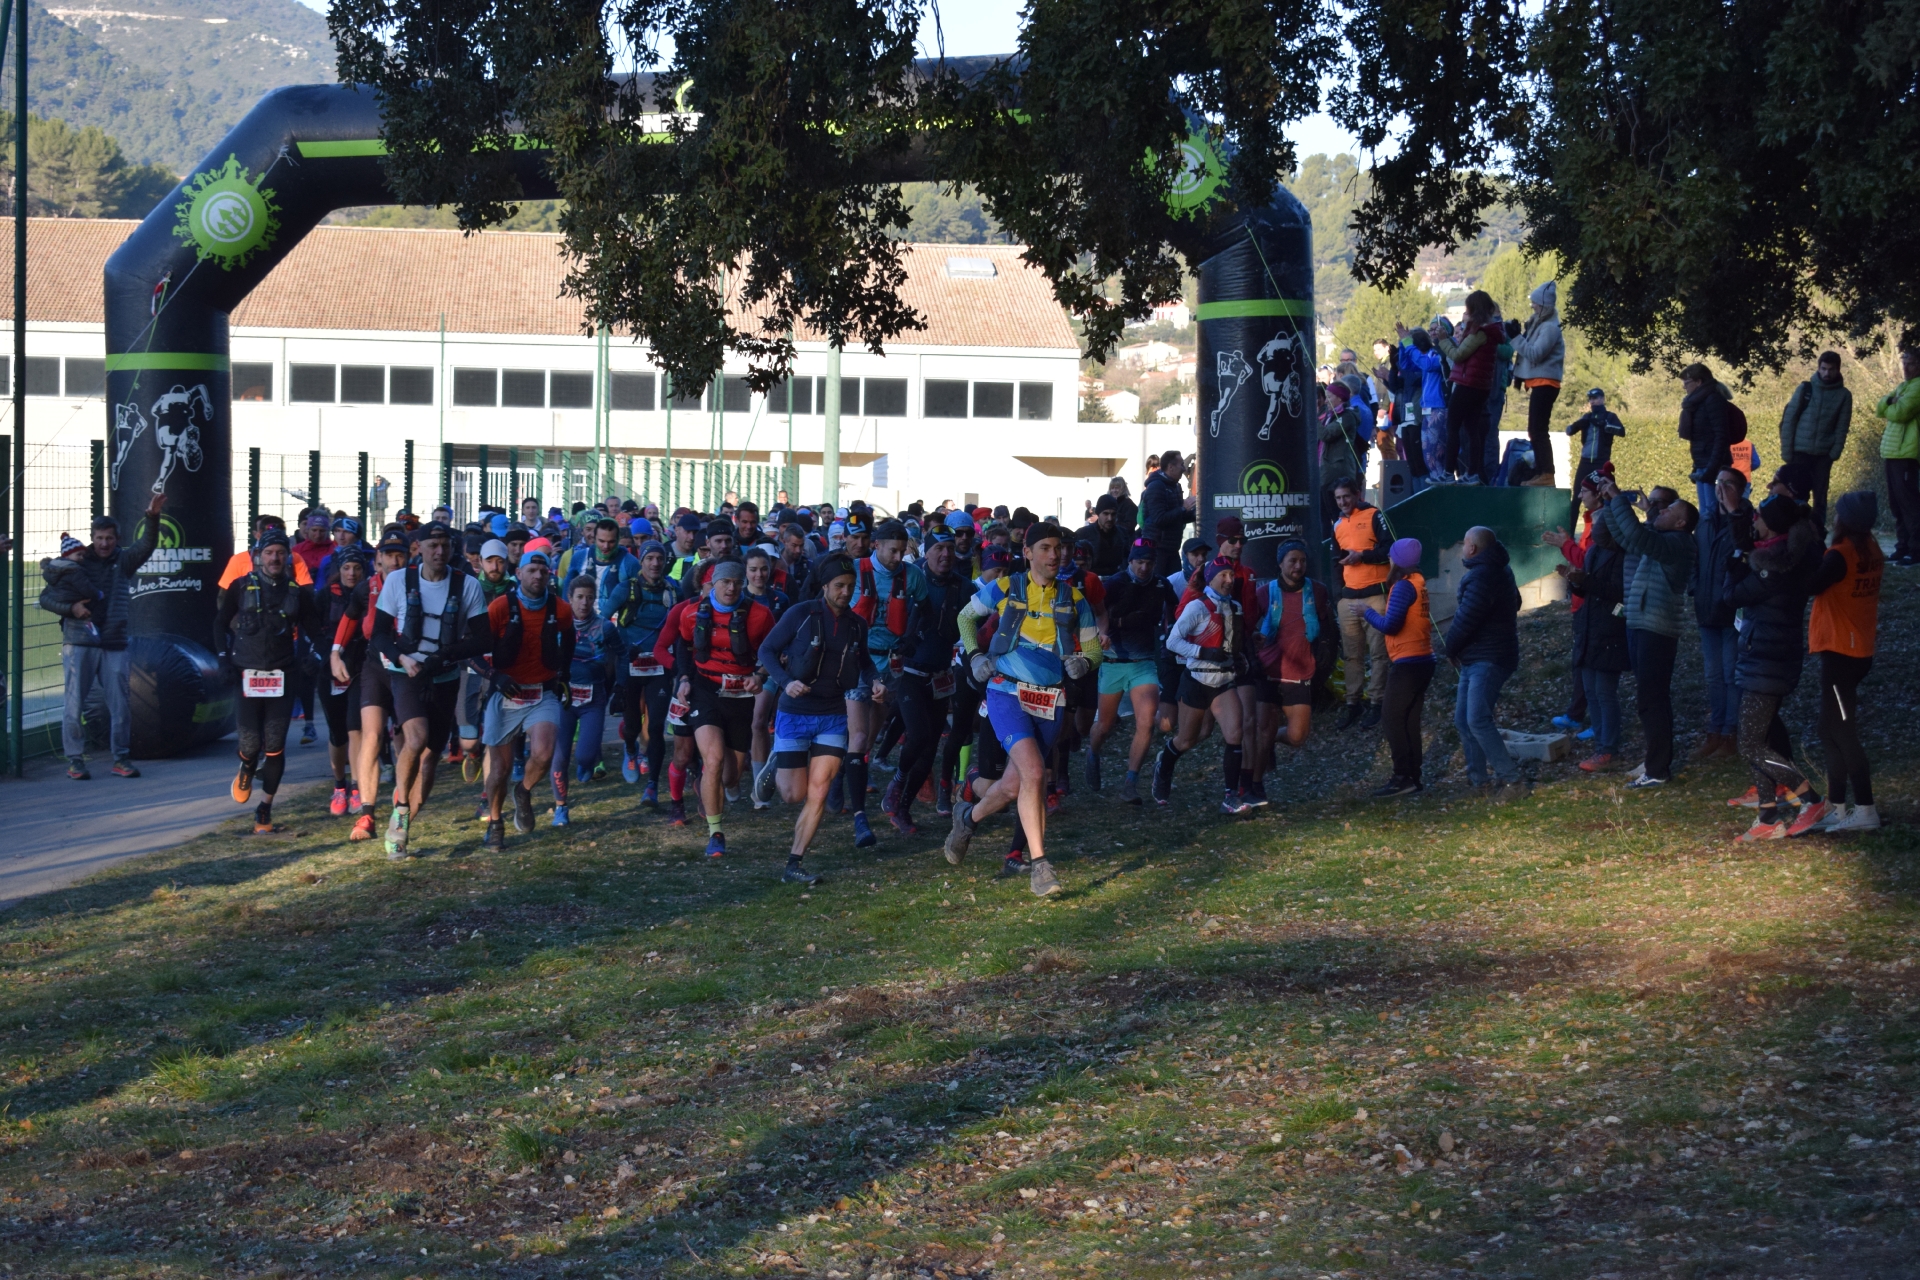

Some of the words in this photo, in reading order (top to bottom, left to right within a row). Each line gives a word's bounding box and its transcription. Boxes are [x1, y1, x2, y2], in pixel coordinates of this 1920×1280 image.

[1214, 494, 1310, 508] ENDURANCE
[1242, 506, 1287, 519] SHOP
[1265, 522, 1303, 535] Running
[150, 548, 212, 561] RANCE
[137, 578, 157, 592] love
[158, 576, 202, 591] Running
[251, 678, 278, 688] 3073
[1022, 691, 1051, 706] 3089
